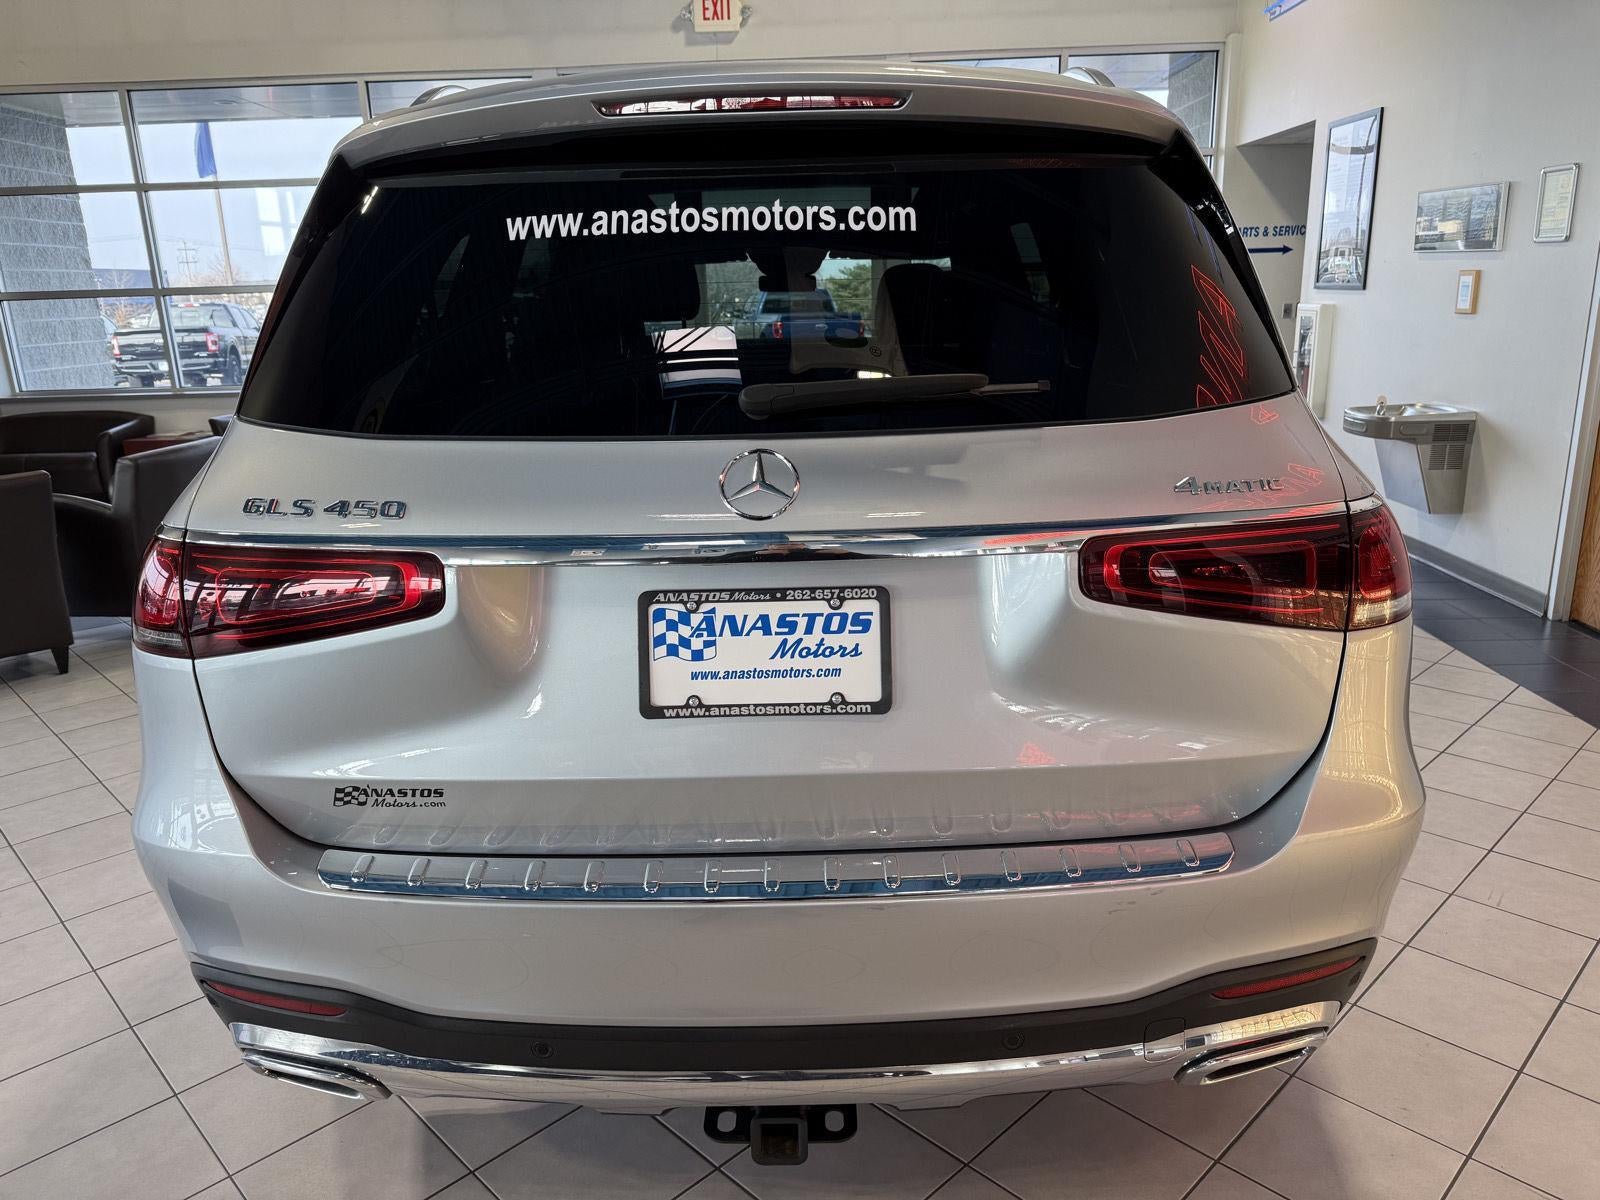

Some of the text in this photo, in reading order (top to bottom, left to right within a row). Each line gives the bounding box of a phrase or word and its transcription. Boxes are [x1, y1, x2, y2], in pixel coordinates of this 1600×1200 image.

[506, 199, 918, 241] www.anastosmotors.com
[1239, 224, 1306, 237] RTS & SERVIC
[1174, 476, 1285, 495] 4MATIC
[243, 498, 407, 519] GLS 450
[653, 588, 877, 602] ANASTOS Motors 262-657-6020
[689, 611, 874, 638] ANASTOS
[768, 637, 863, 660] Motors
[690, 667, 842, 681] www.anastosmotors.com
[663, 703, 872, 718] www.anastosmotors.com
[357, 787, 445, 798] ANASTOS
